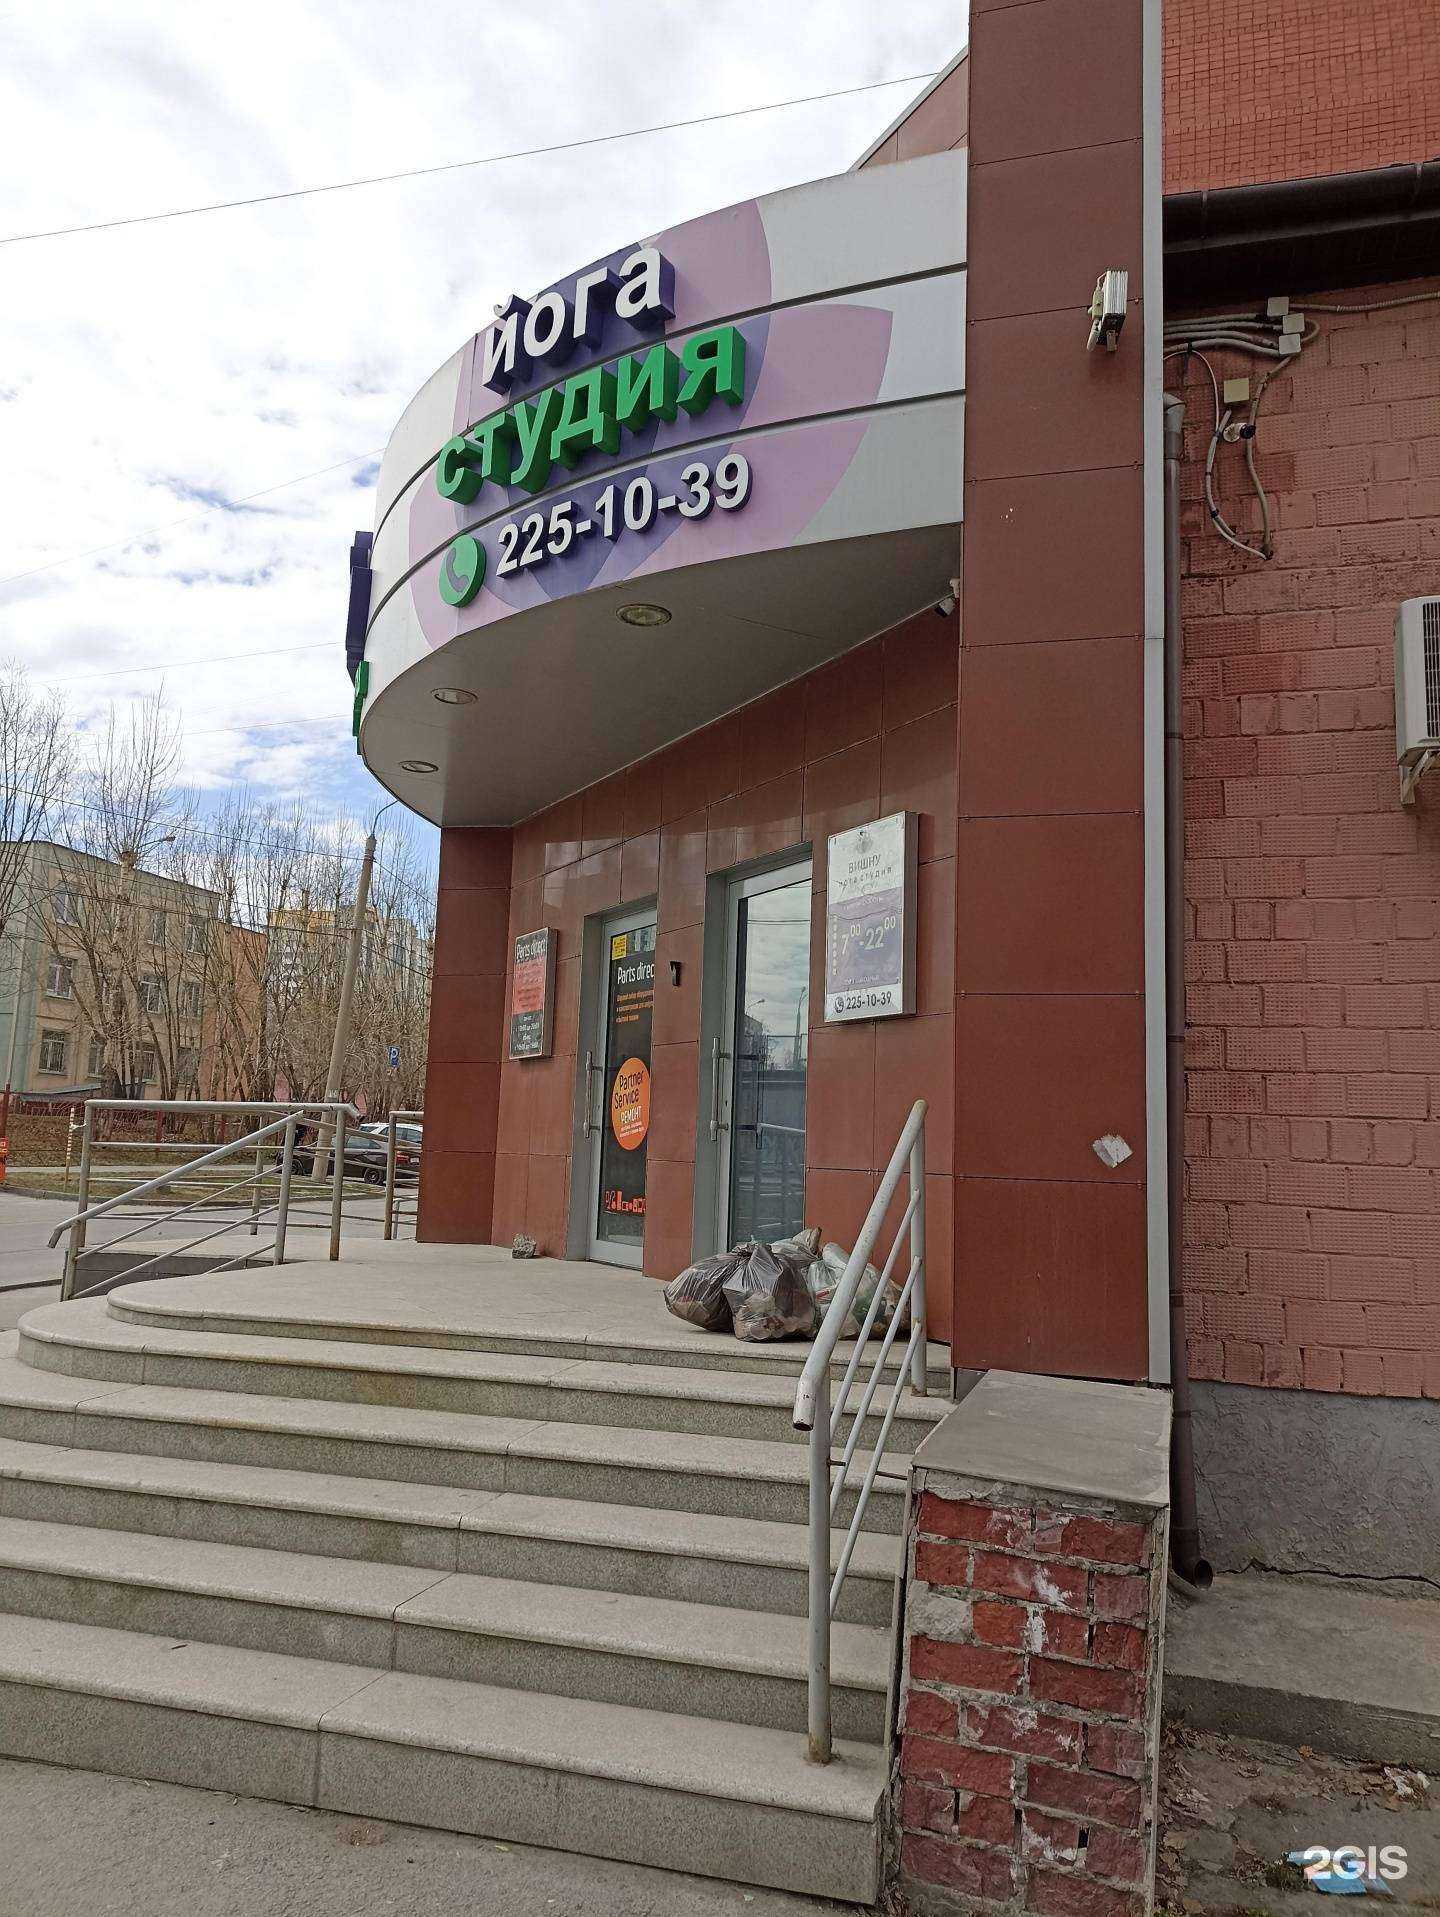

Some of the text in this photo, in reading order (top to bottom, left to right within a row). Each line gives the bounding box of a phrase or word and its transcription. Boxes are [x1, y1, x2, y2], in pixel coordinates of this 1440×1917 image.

[482, 247, 662, 388] йога
[436, 326, 738, 501] студия
[497, 453, 750, 575] 225-10-39
[848, 854, 881, 874] ВИШНУ
[617, 966, 636, 985] Parts
[846, 991, 892, 1011] 225-10-39
[619, 1071, 644, 1091] Partner
[614, 1089, 640, 1110] Service
[621, 1105, 642, 1124] РЕМОНТ
